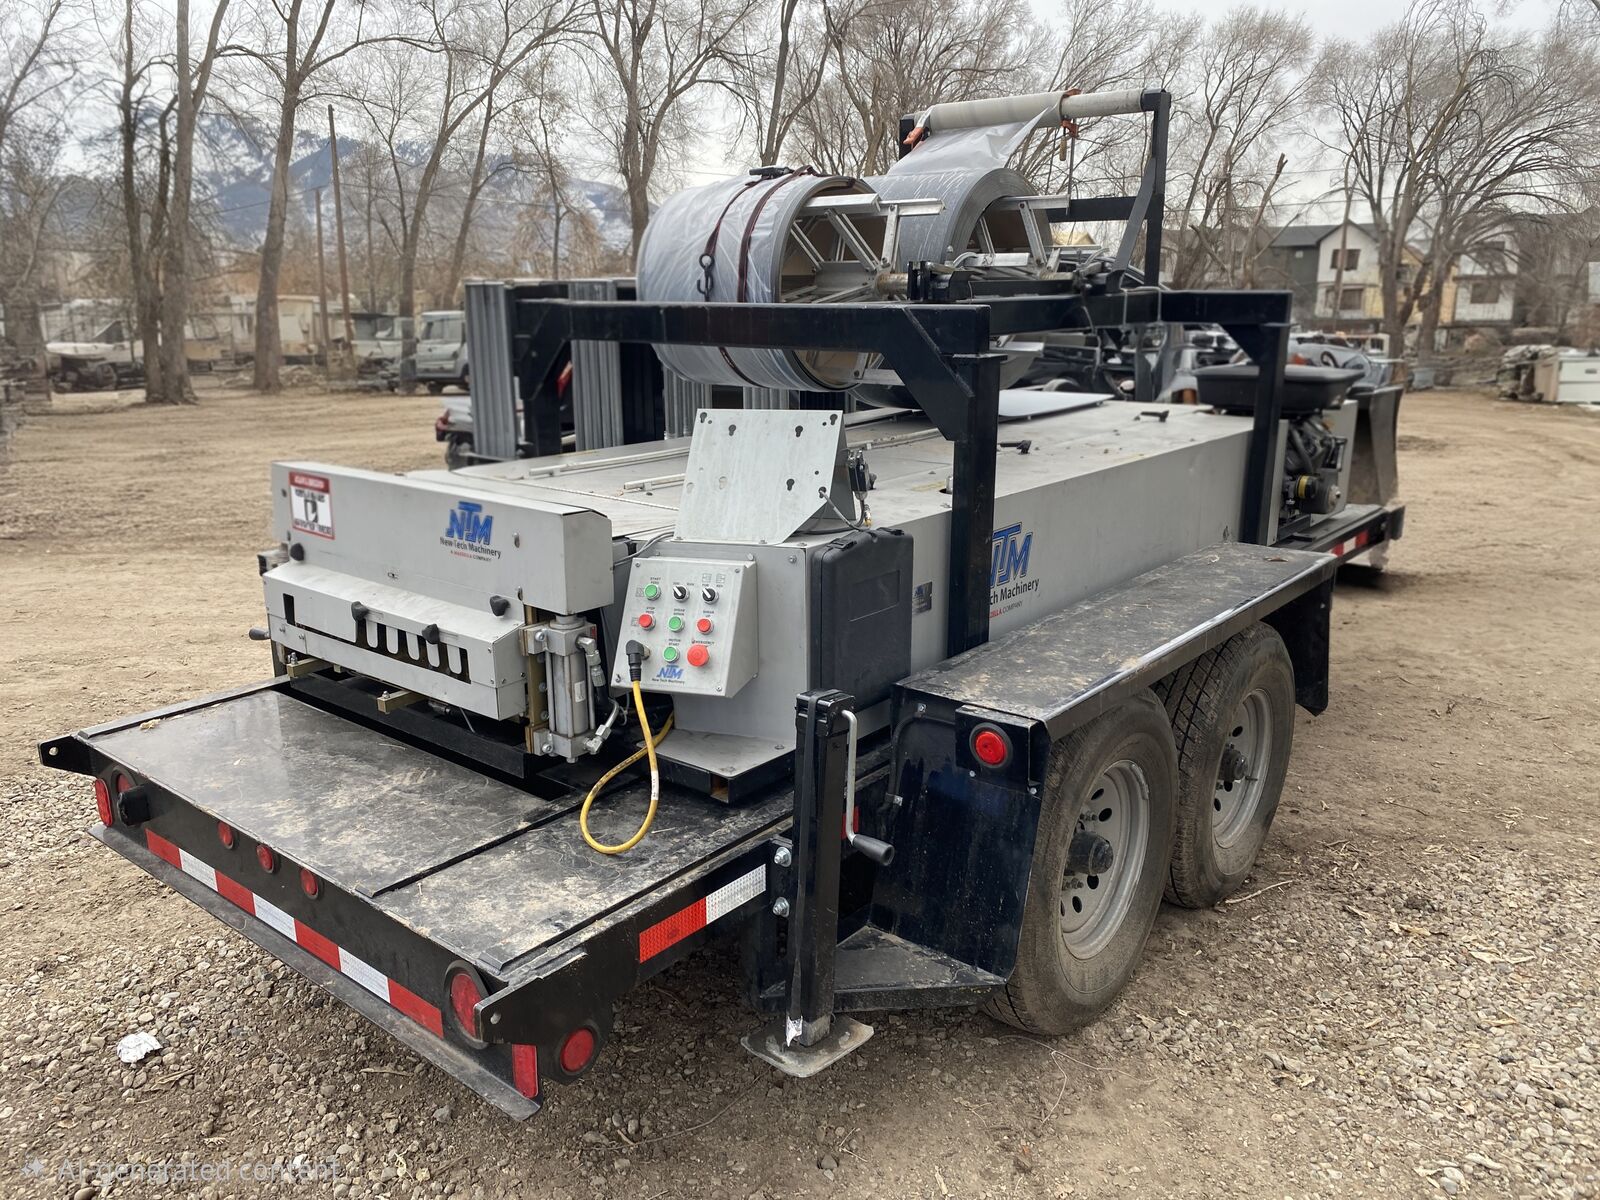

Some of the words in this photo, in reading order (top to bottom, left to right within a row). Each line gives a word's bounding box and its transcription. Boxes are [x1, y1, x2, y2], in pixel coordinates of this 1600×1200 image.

[446, 501, 493, 545] NTM
[440, 537, 453, 547] New
[454, 540, 468, 550] Tech
[468, 543, 502, 559] Machinery
[1000, 578, 1040, 601] Machinery
[656, 664, 684, 679] NTM
